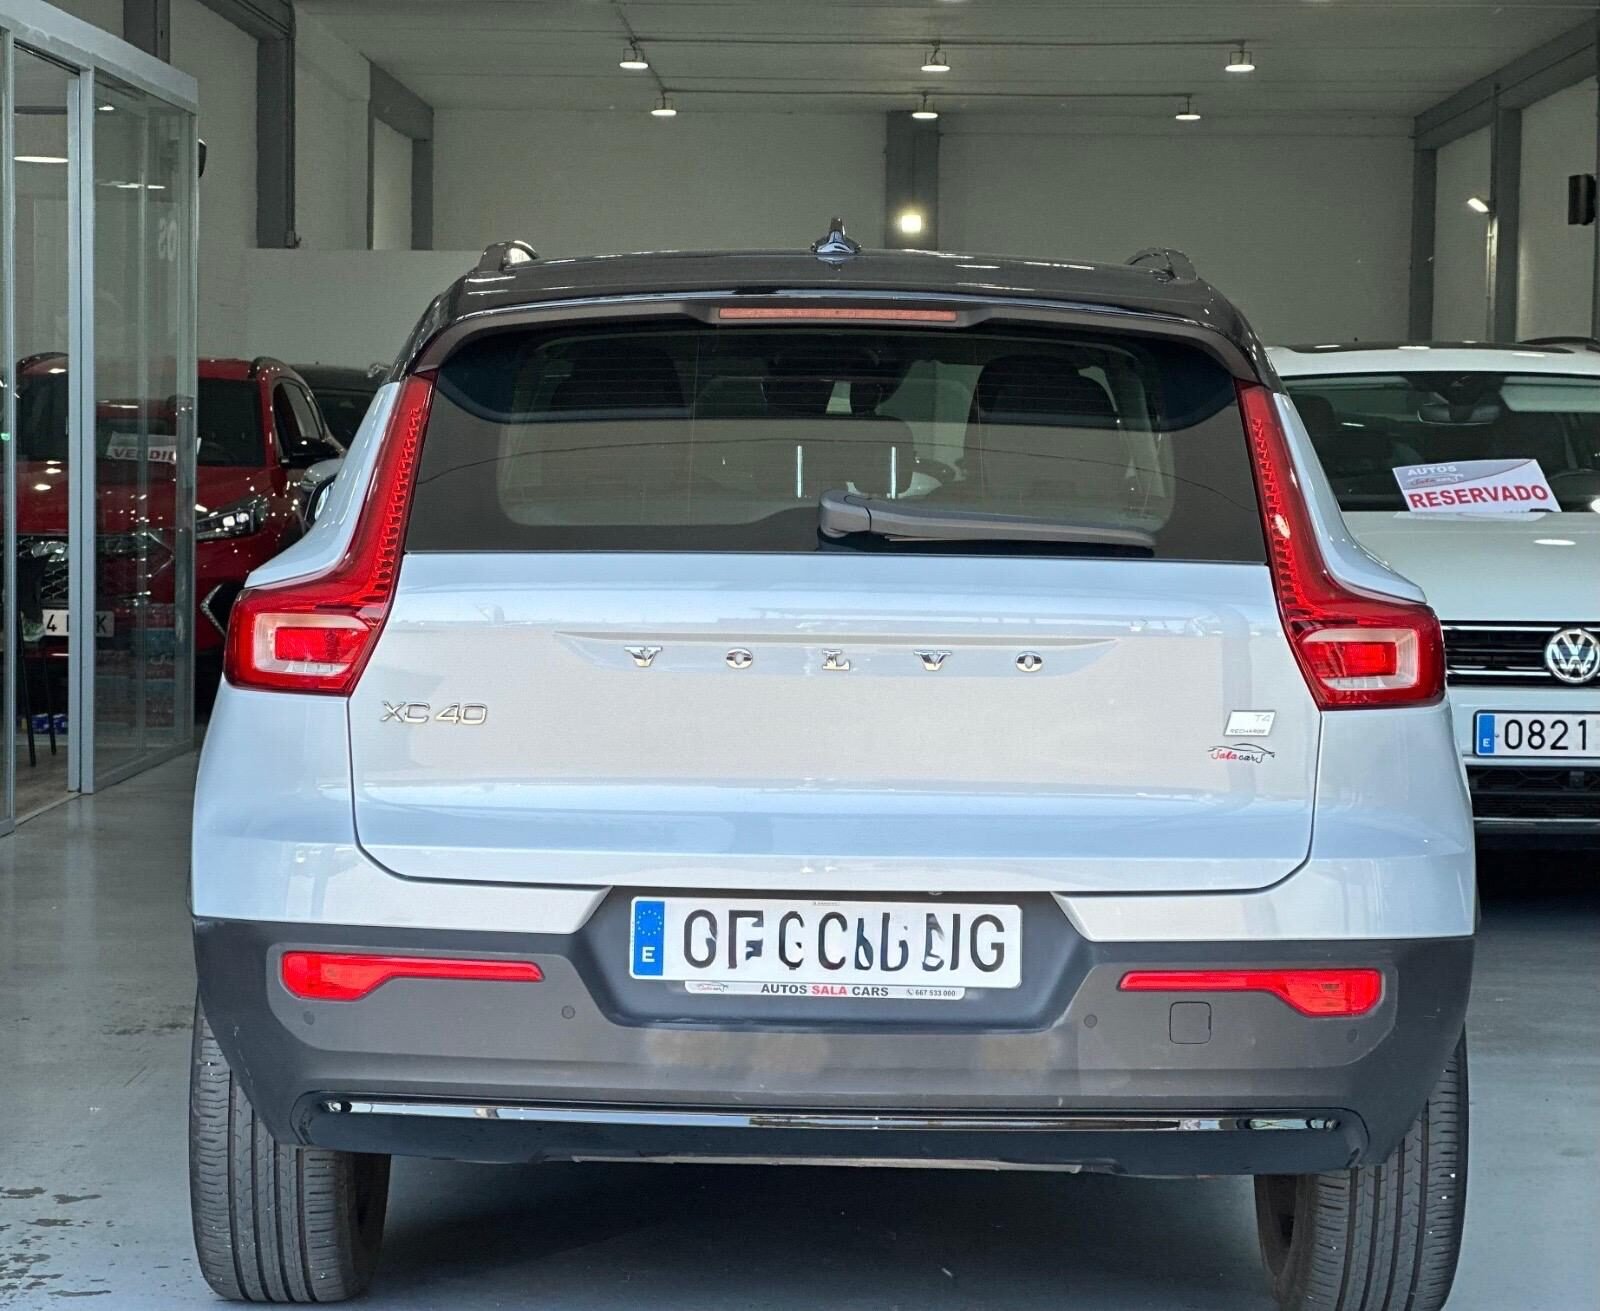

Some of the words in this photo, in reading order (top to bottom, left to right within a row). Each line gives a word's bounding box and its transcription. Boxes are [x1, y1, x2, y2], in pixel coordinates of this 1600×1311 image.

[1407, 465, 1457, 476] AUTOS
[1408, 484, 1549, 508] RESERVADO
[623, 646, 1044, 673] VOLVO
[1504, 719, 1587, 751] 0821
[641, 946, 656, 963] E
[761, 984, 808, 994] AUTOS
[811, 985, 848, 996] SALA
[852, 986, 889, 997] CARS
